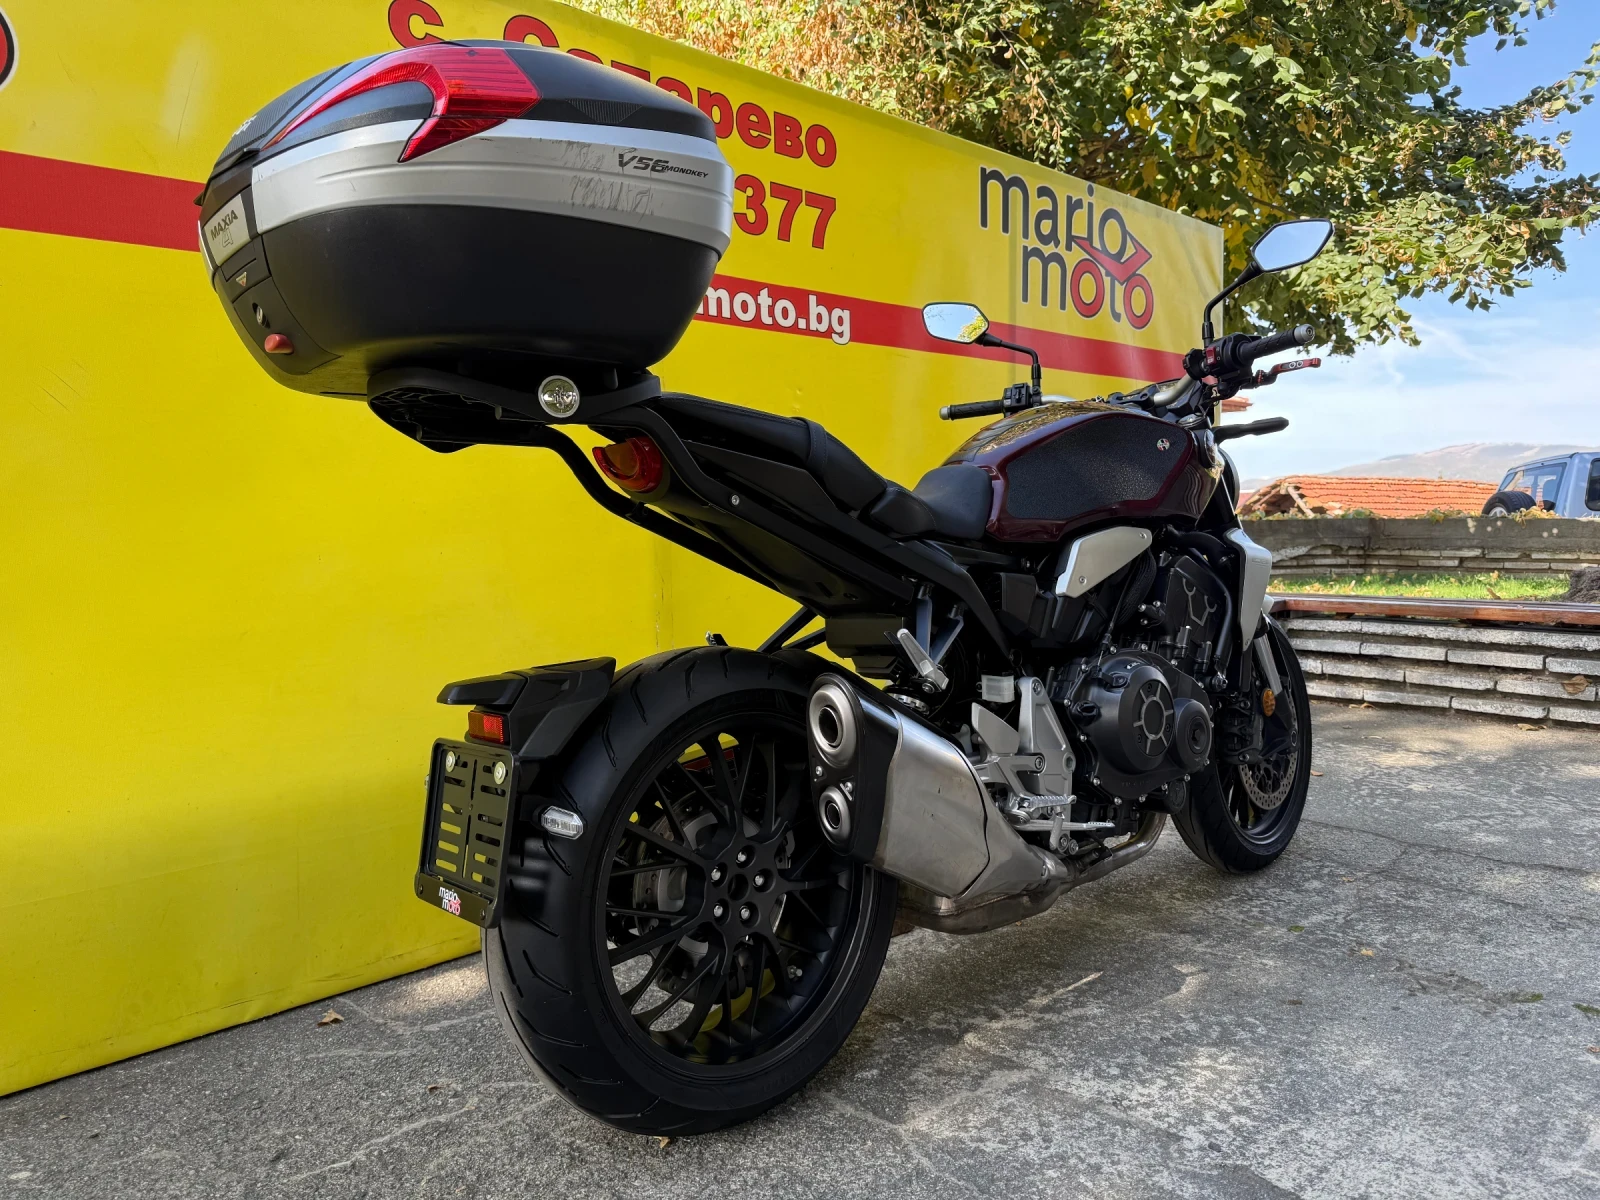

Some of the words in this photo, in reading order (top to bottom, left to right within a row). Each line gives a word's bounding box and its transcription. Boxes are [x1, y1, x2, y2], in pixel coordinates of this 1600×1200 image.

[618, 153, 669, 174] V56
[665, 164, 709, 179] MONOKEY
[733, 173, 837, 250] 377
[980, 166, 1128, 264] mario
[696, 286, 851, 346] moto.bg
[1021, 244, 1155, 330] moto
